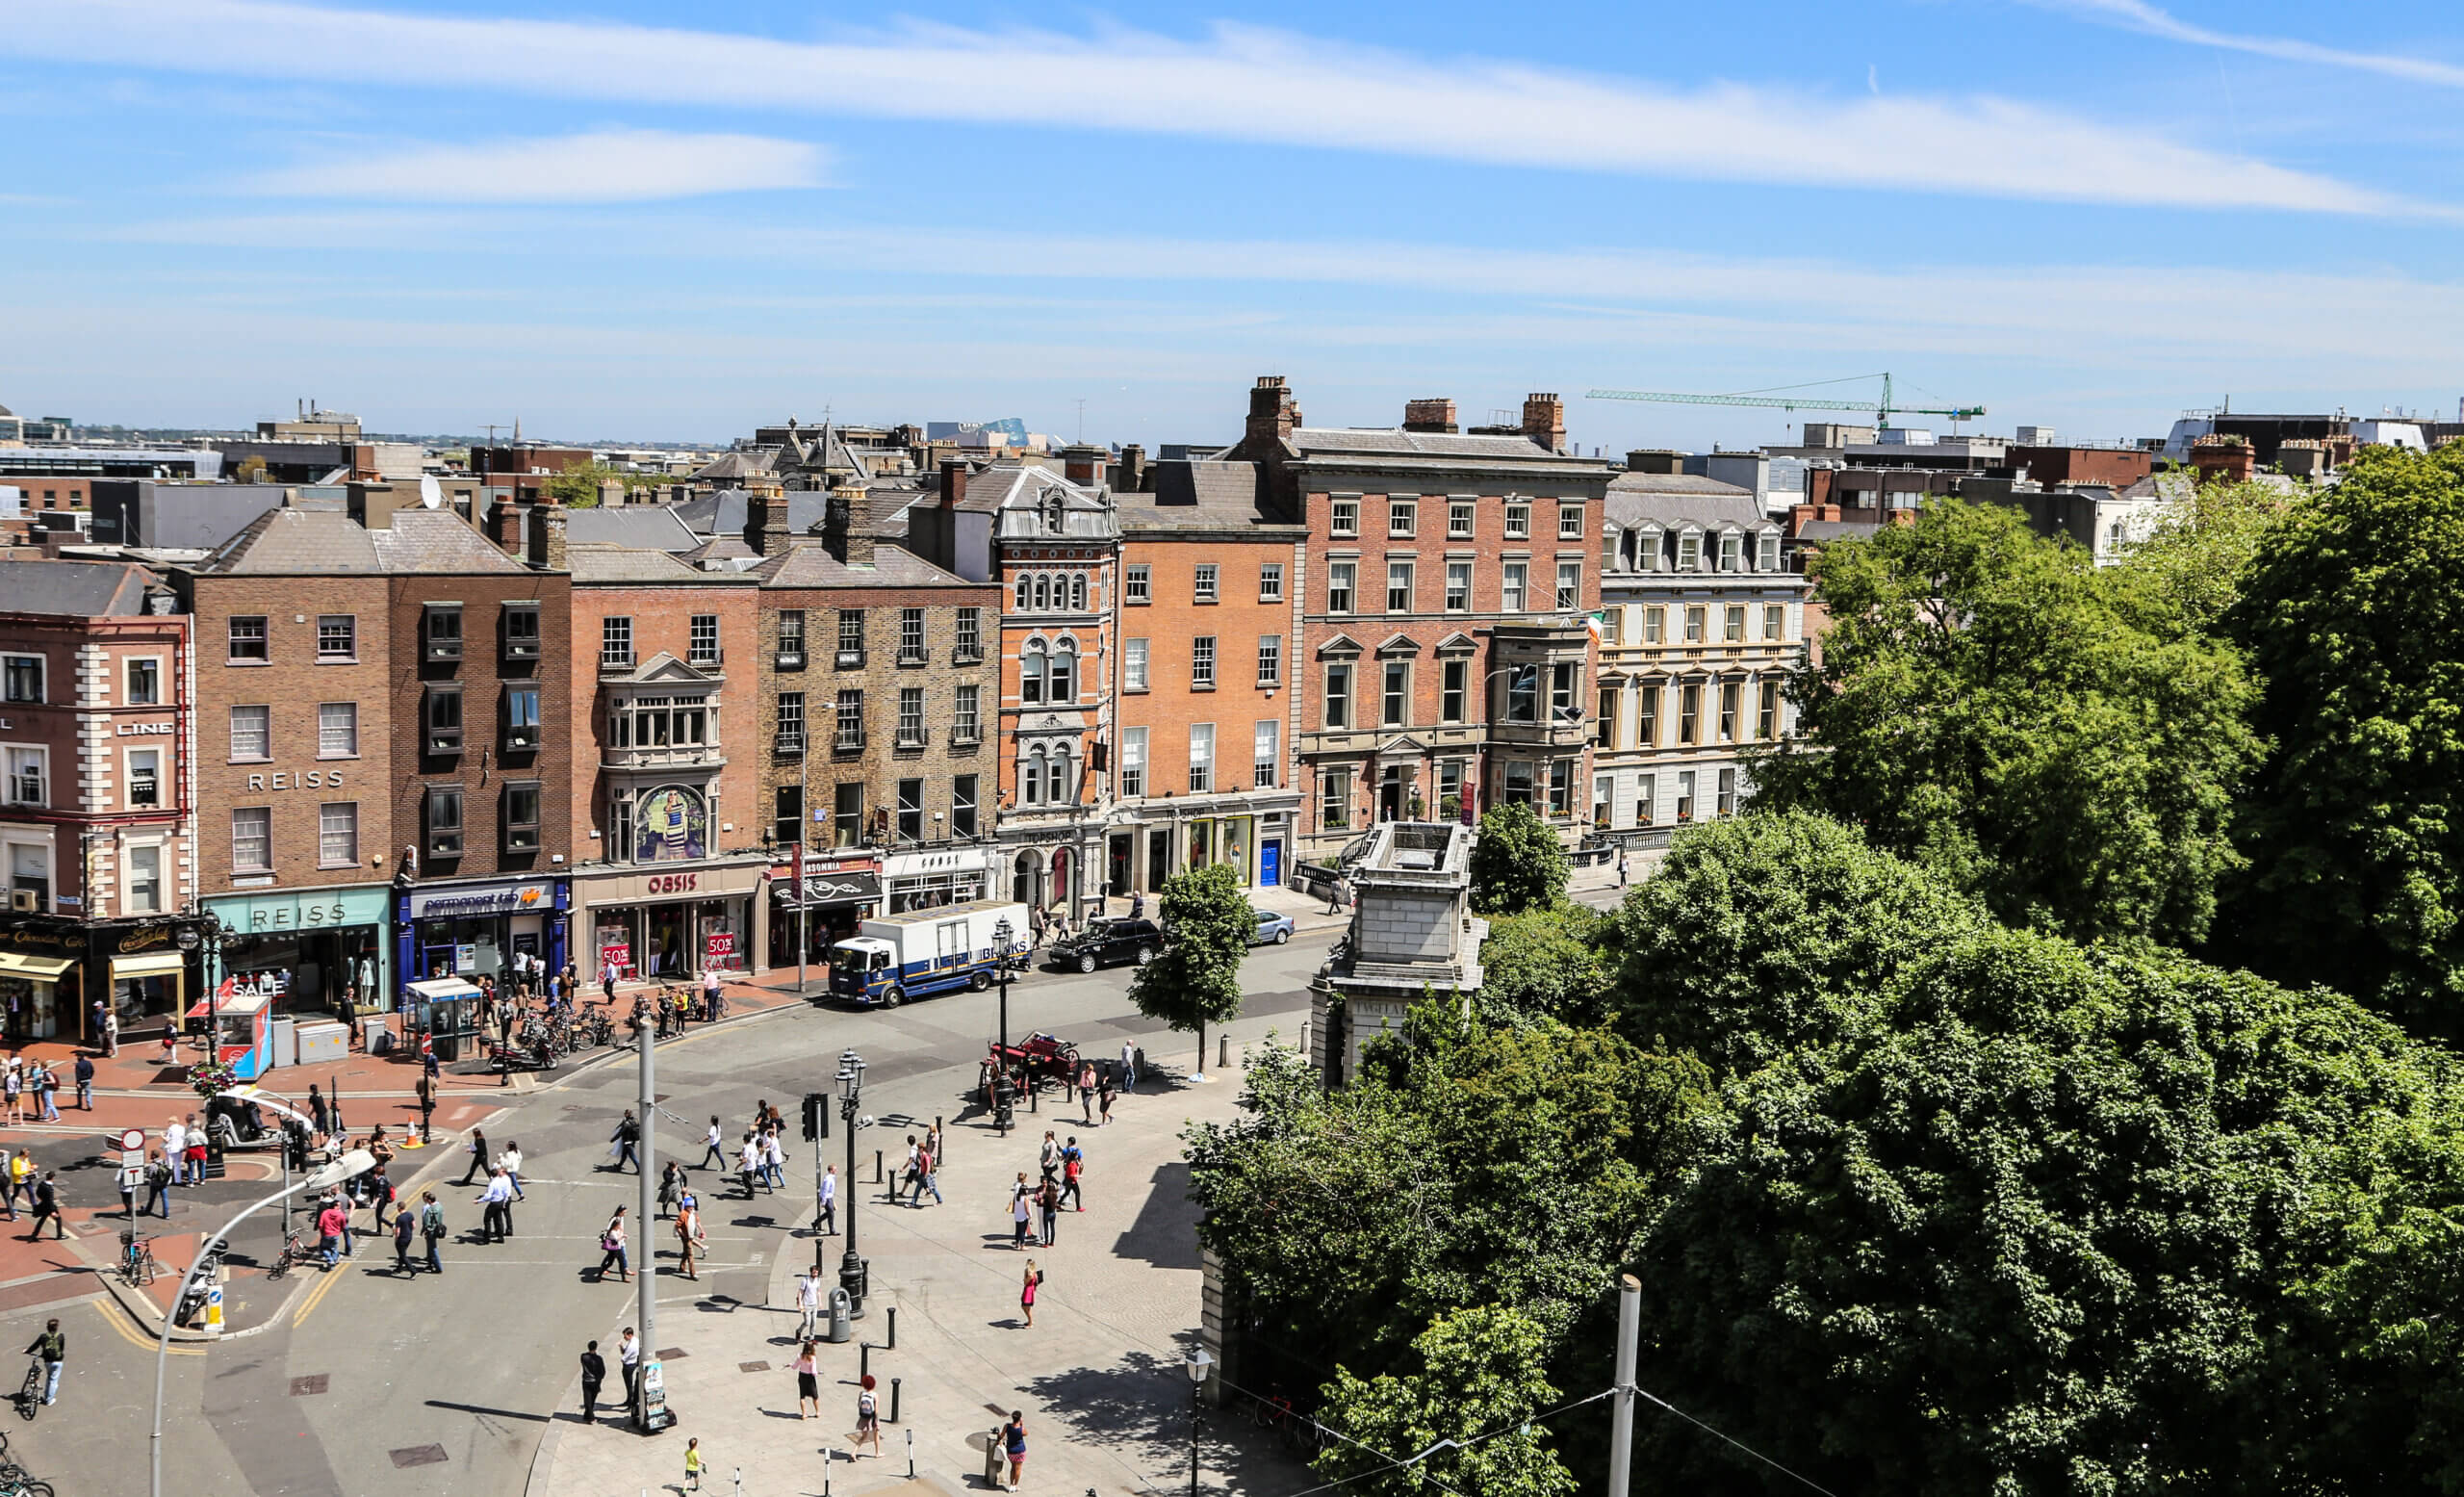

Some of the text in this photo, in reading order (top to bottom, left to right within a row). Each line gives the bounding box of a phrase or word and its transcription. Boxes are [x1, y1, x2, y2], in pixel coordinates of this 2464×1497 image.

[248, 770, 344, 790] REISS
[1027, 831, 1071, 843] TOPSHOP
[806, 861, 840, 873] NSOMNIA
[253, 904, 346, 925] REISS
[597, 968, 639, 984] SLE
[232, 980, 286, 996] SALE
